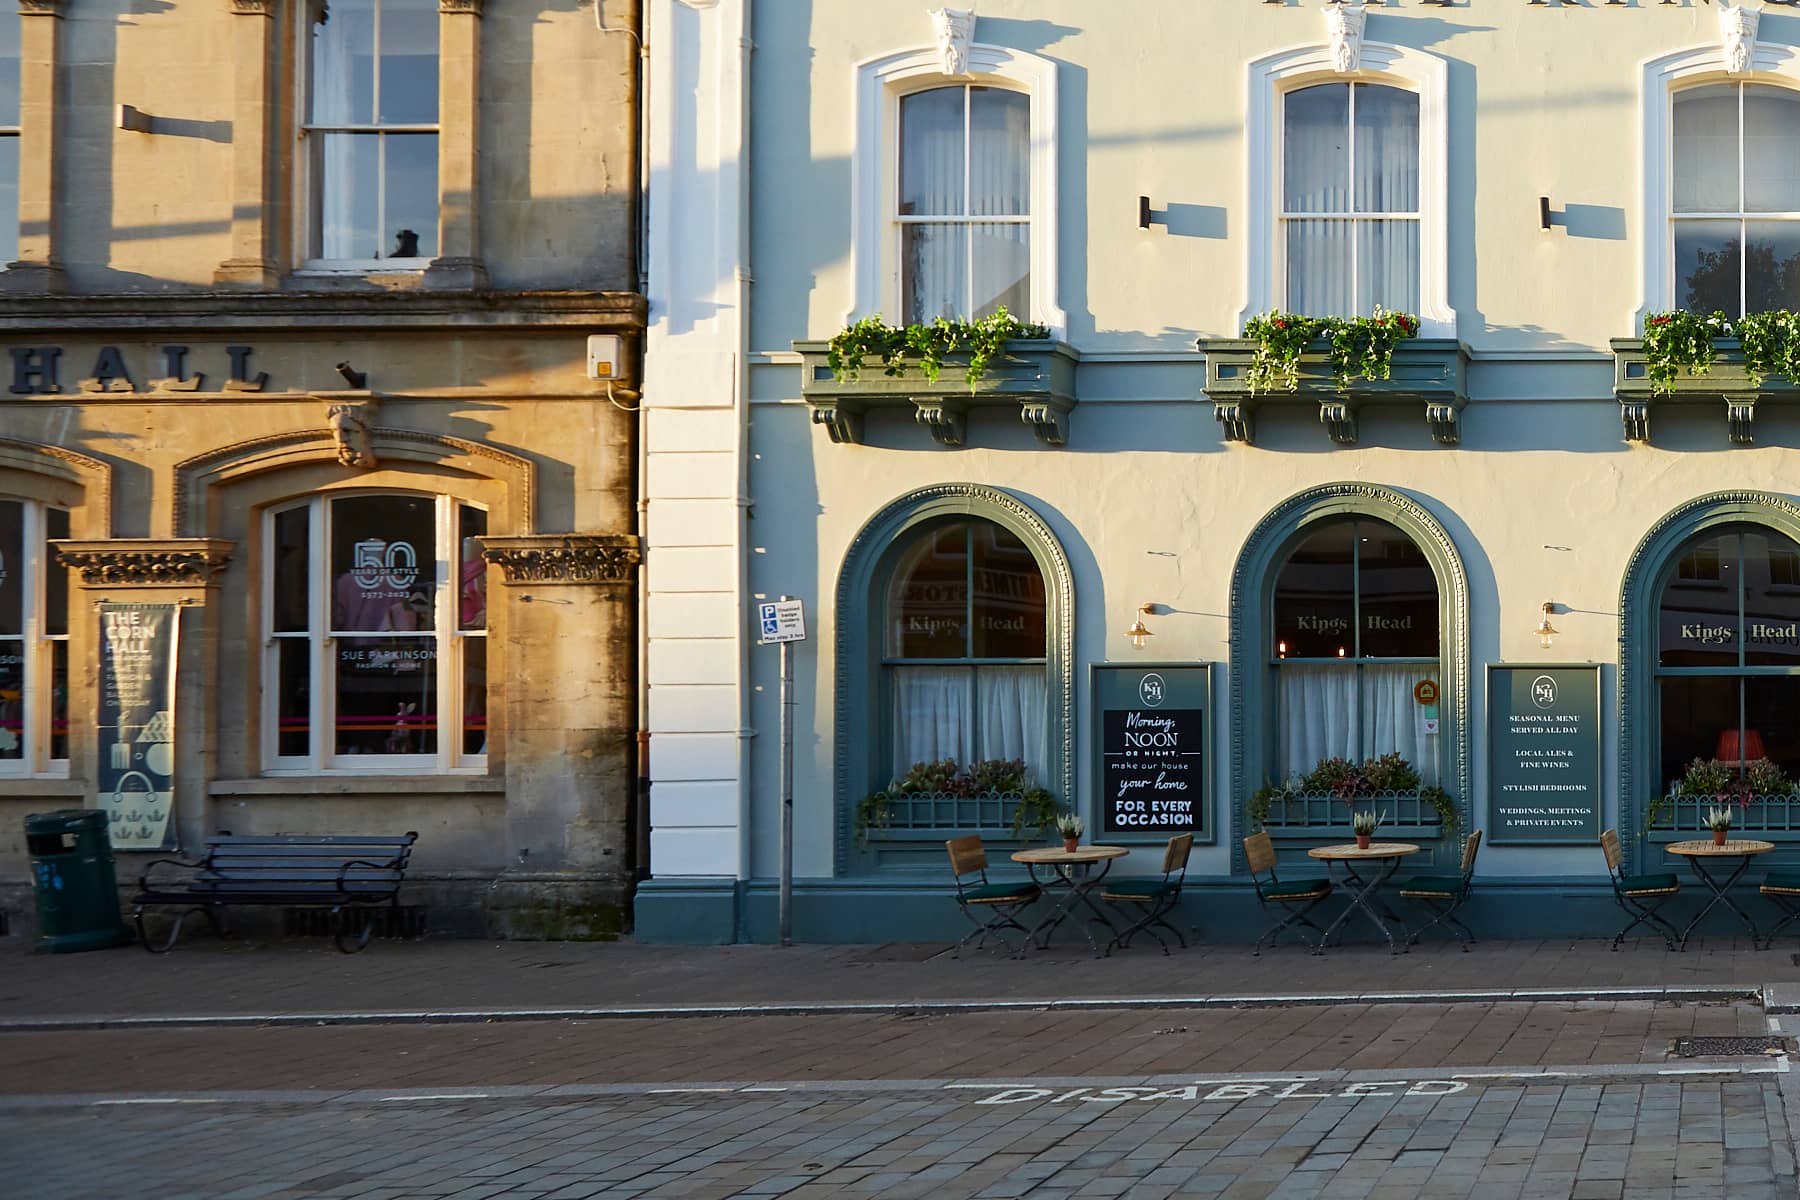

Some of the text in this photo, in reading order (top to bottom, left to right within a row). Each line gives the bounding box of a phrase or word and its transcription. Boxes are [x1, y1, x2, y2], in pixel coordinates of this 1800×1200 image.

[8, 346, 269, 393] HALL
[354, 541, 416, 589] 50
[104, 612, 140, 624] THE
[909, 616, 1025, 636] Kings Head
[1297, 616, 1412, 635] Kings Head
[106, 626, 156, 639] CORN
[1681, 624, 1732, 644] Kings
[1751, 623, 1798, 638] Head
[106, 640, 150, 654] HALL
[341, 650, 437, 660] SUE PARKINSON
[1126, 711, 1176, 733] Morning,
[1124, 732, 1179, 748] NOON
[1111, 762, 1138, 770] make
[1161, 761, 1189, 770] house
[1117, 771, 1188, 797] your home
[1115, 800, 1192, 812] FOR EVERY
[1499, 807, 1547, 815] WEDDINGS,
[1115, 813, 1193, 826] OCCASION
[974, 1080, 1470, 1105] DISABLED
